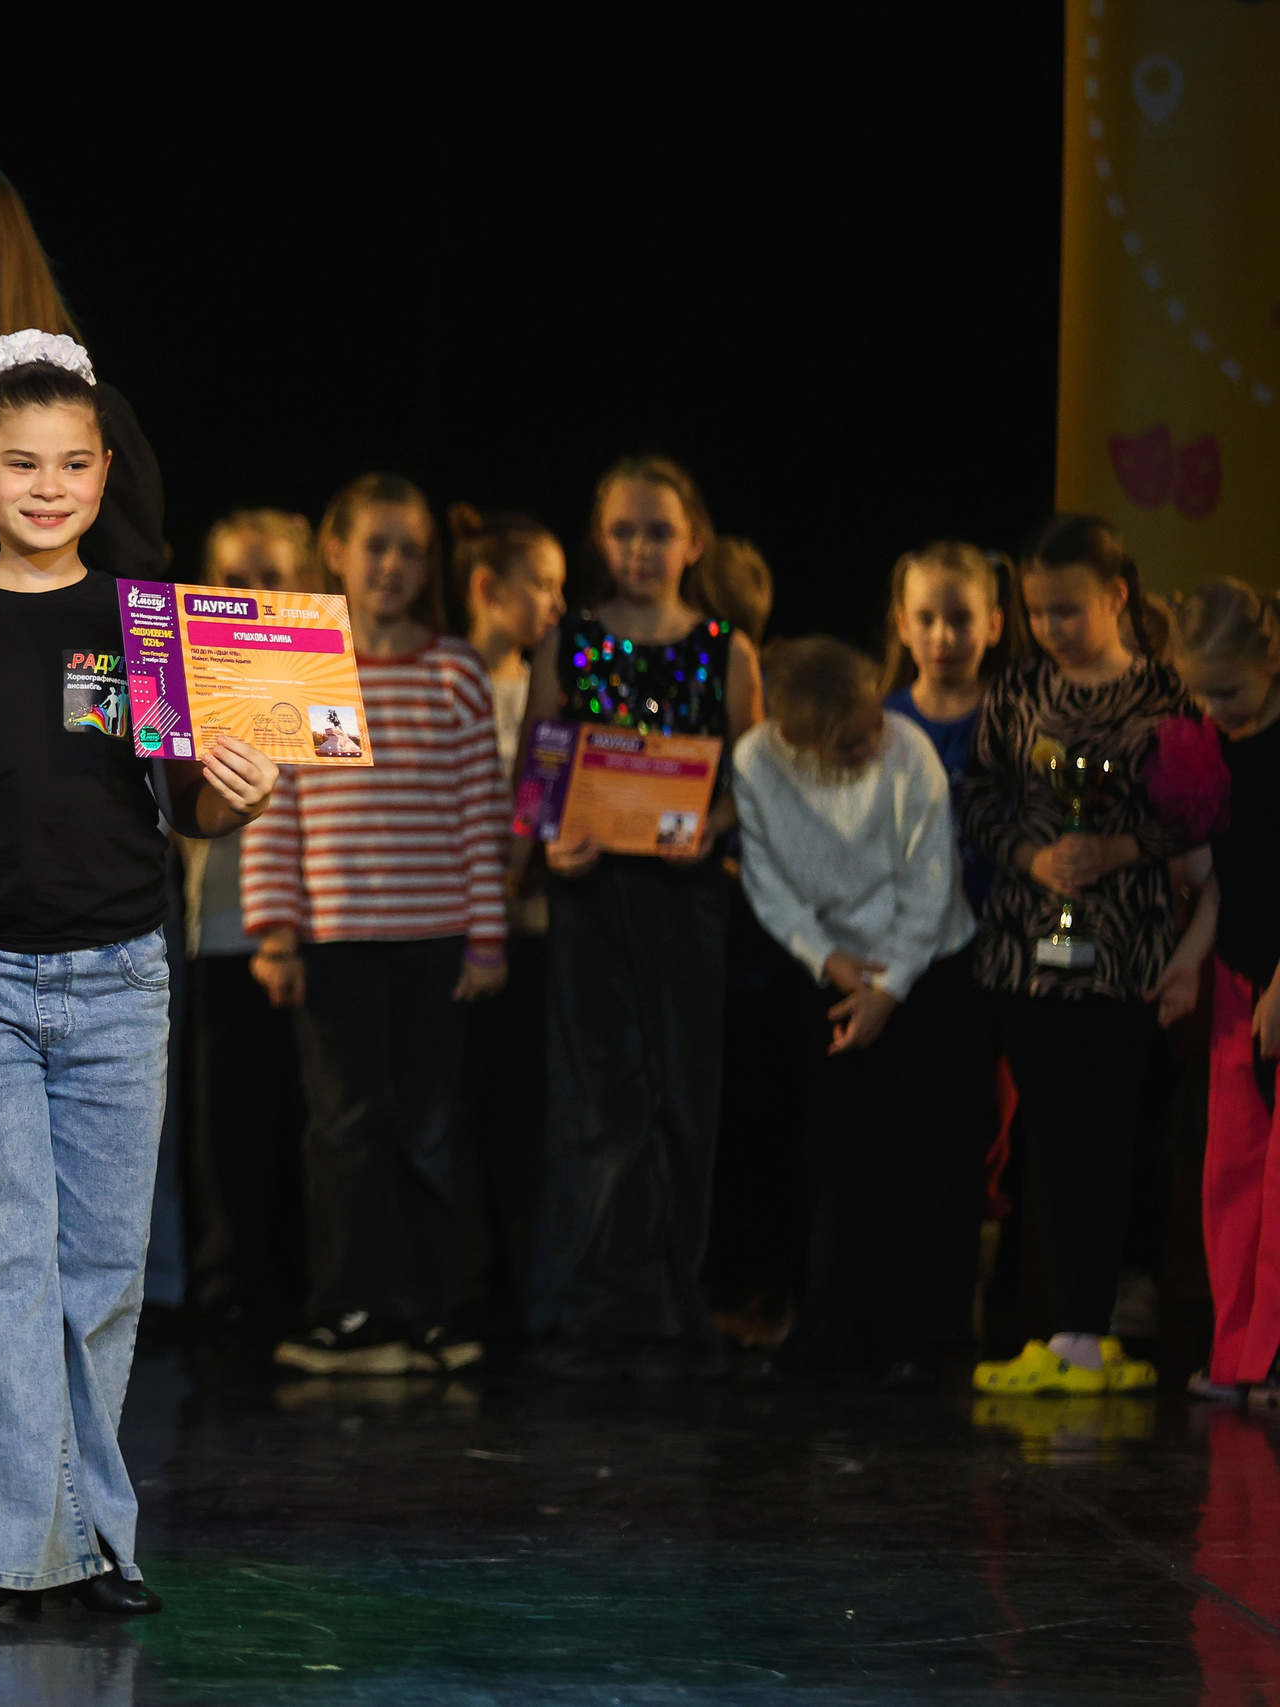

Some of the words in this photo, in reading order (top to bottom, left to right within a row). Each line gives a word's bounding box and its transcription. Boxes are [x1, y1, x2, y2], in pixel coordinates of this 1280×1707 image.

[138, 597, 166, 612] могу!
[193, 599, 249, 615] ЛАУРЕАТ
[281, 608, 320, 619] СТЕПЕНИ
[233, 632, 269, 642] КУШХОВА
[269, 633, 293, 644] ЭЛИНА
[66, 683, 103, 691] ансамбль
